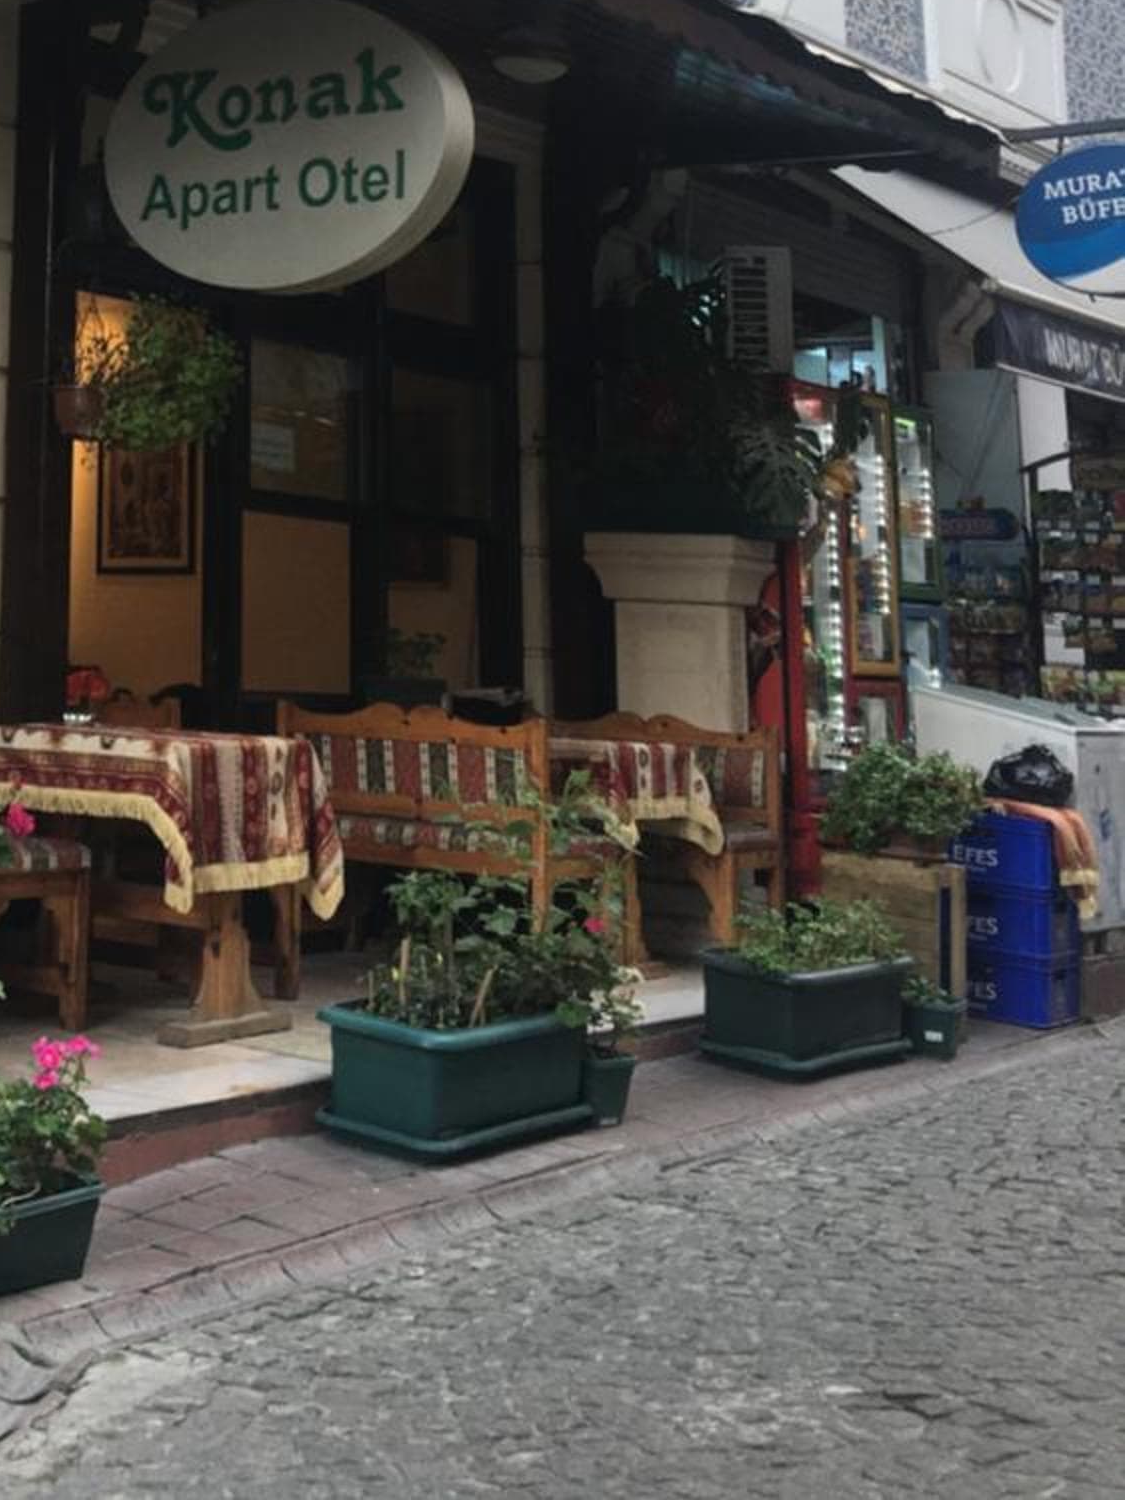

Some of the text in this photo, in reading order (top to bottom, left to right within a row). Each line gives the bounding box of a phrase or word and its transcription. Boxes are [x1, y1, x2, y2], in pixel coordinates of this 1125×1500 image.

[142, 47, 406, 152] Konak
[140, 149, 406, 232] Apart Otel
[953, 844, 999, 867] EFES
